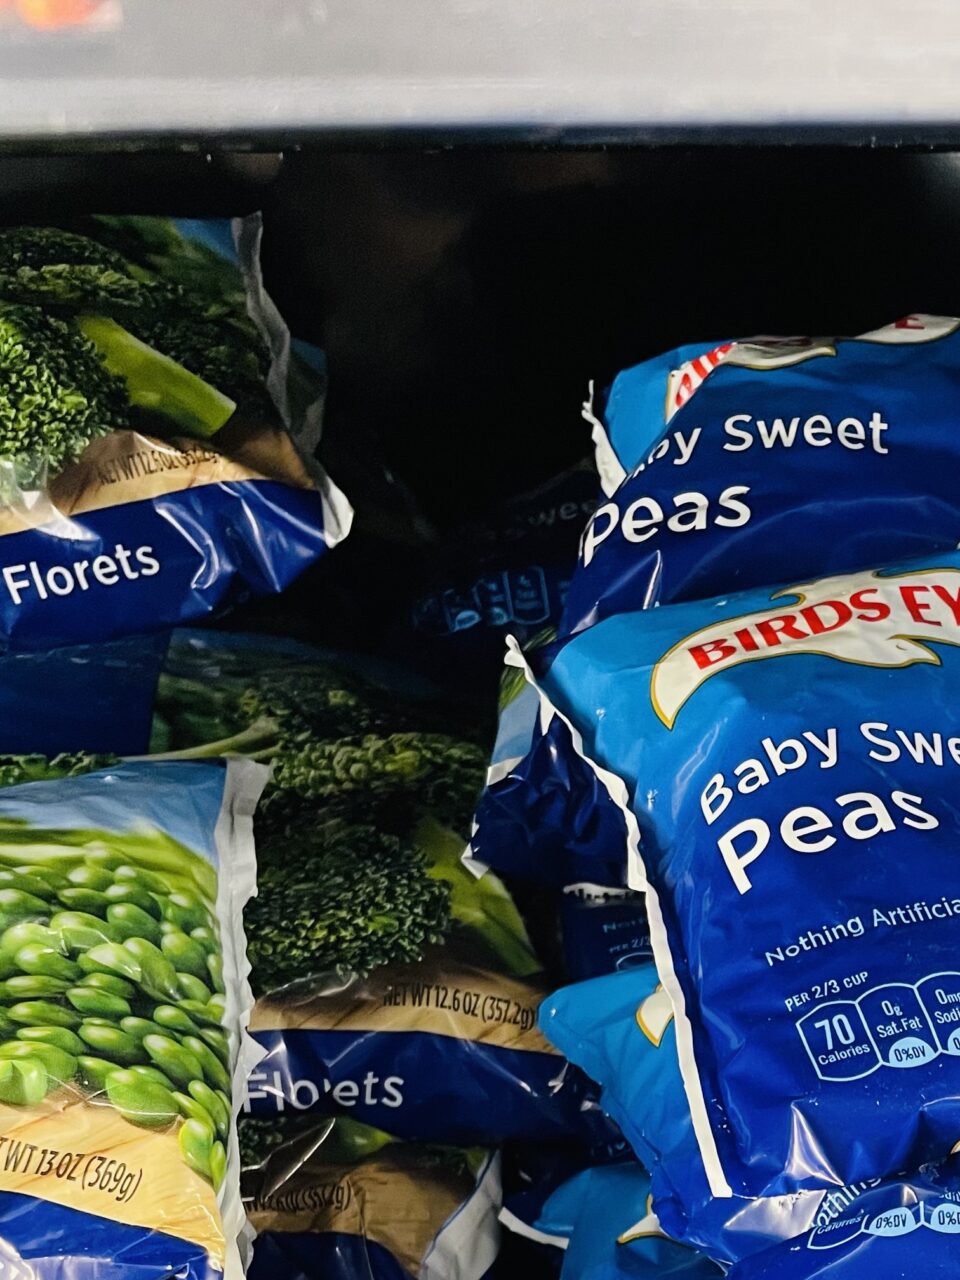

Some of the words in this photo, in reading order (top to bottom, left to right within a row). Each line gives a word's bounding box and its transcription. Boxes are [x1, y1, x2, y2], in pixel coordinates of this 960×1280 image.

[723, 411, 889, 454] Sweet
[580, 485, 751, 568] Peas
[3, 542, 160, 604] Florets
[688, 588, 890, 669] BIRDS
[700, 727, 839, 826] Baby
[716, 789, 940, 895] Peas
[764, 915, 864, 967] Nothing
[410, 984, 434, 1008] WT
[434, 984, 461, 1013] 12.6
[464, 991, 481, 1018] OZ
[482, 995, 537, 1031] (357.2g)
[784, 991, 811, 1012] PER
[811, 980, 840, 999] 2/3
[843, 971, 869, 989] CUP
[814, 1013, 856, 1051] 70
[818, 1042, 871, 1066] Calories
